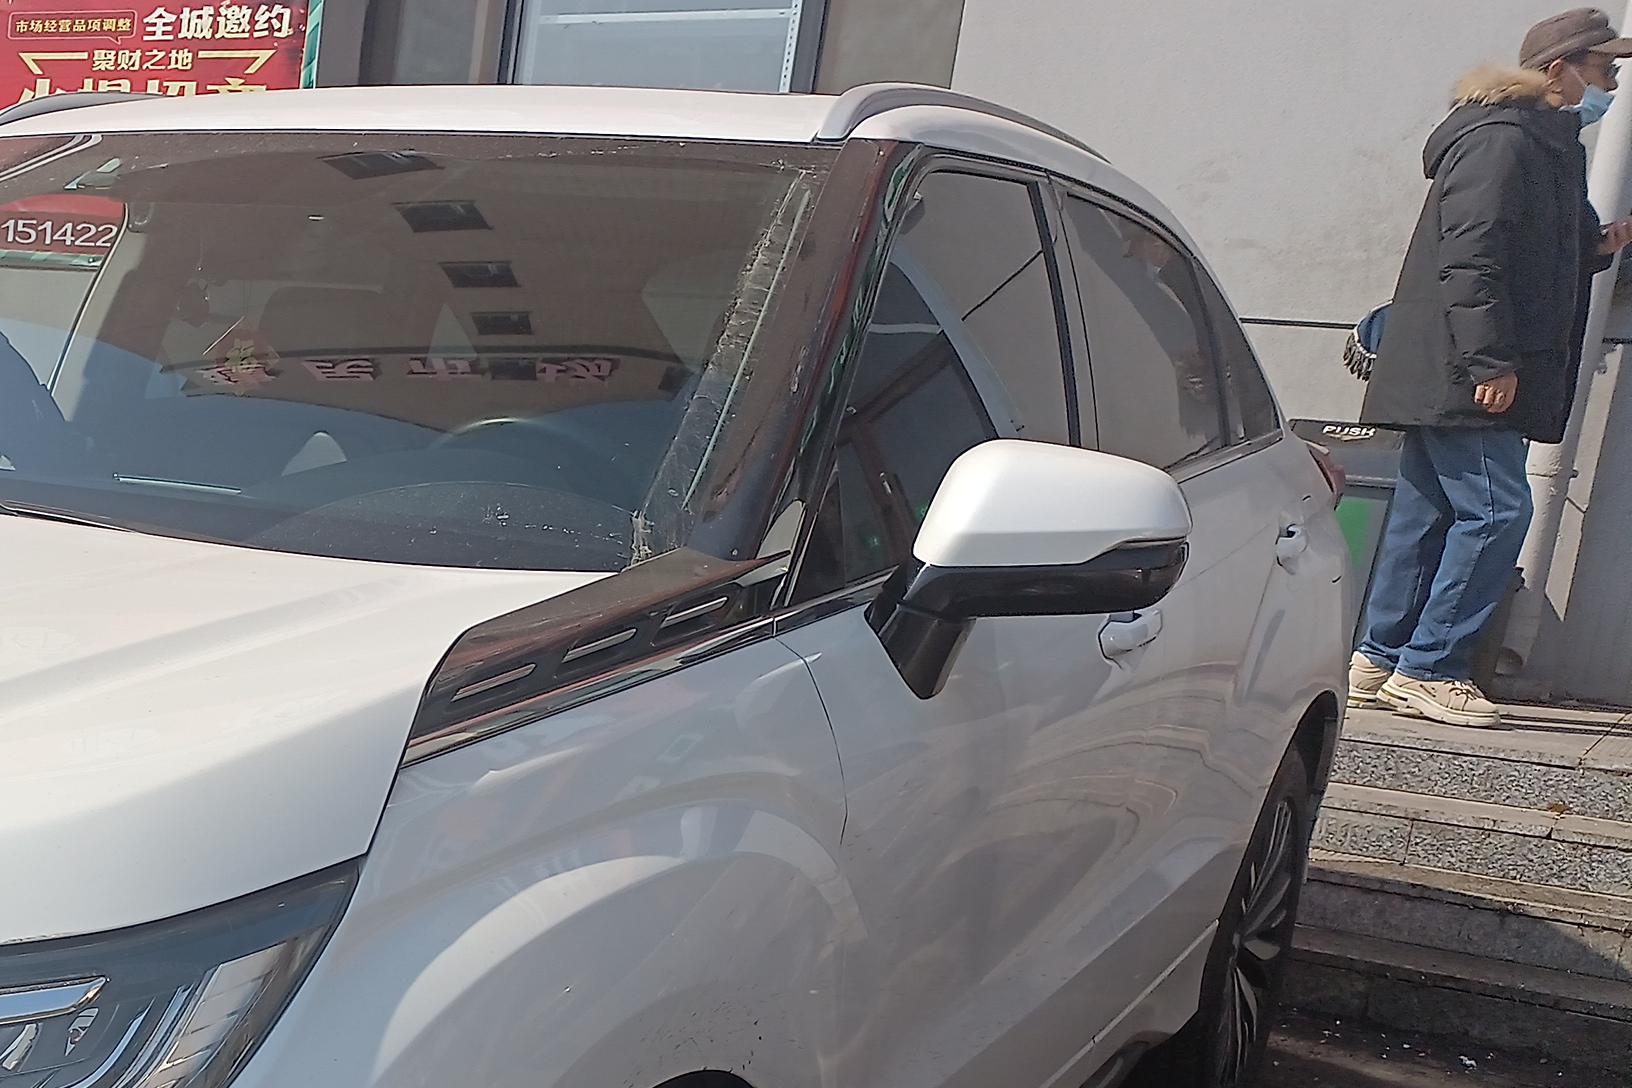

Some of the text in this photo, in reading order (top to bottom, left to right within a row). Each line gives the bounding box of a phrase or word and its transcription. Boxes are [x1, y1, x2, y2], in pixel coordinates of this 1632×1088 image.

[15, 18, 132, 33] 市场经营品项调整
[142, 3, 292, 41] 全城邀约
[91, 49, 193, 71] 聚财之地
[1323, 424, 1376, 437] PUSH
